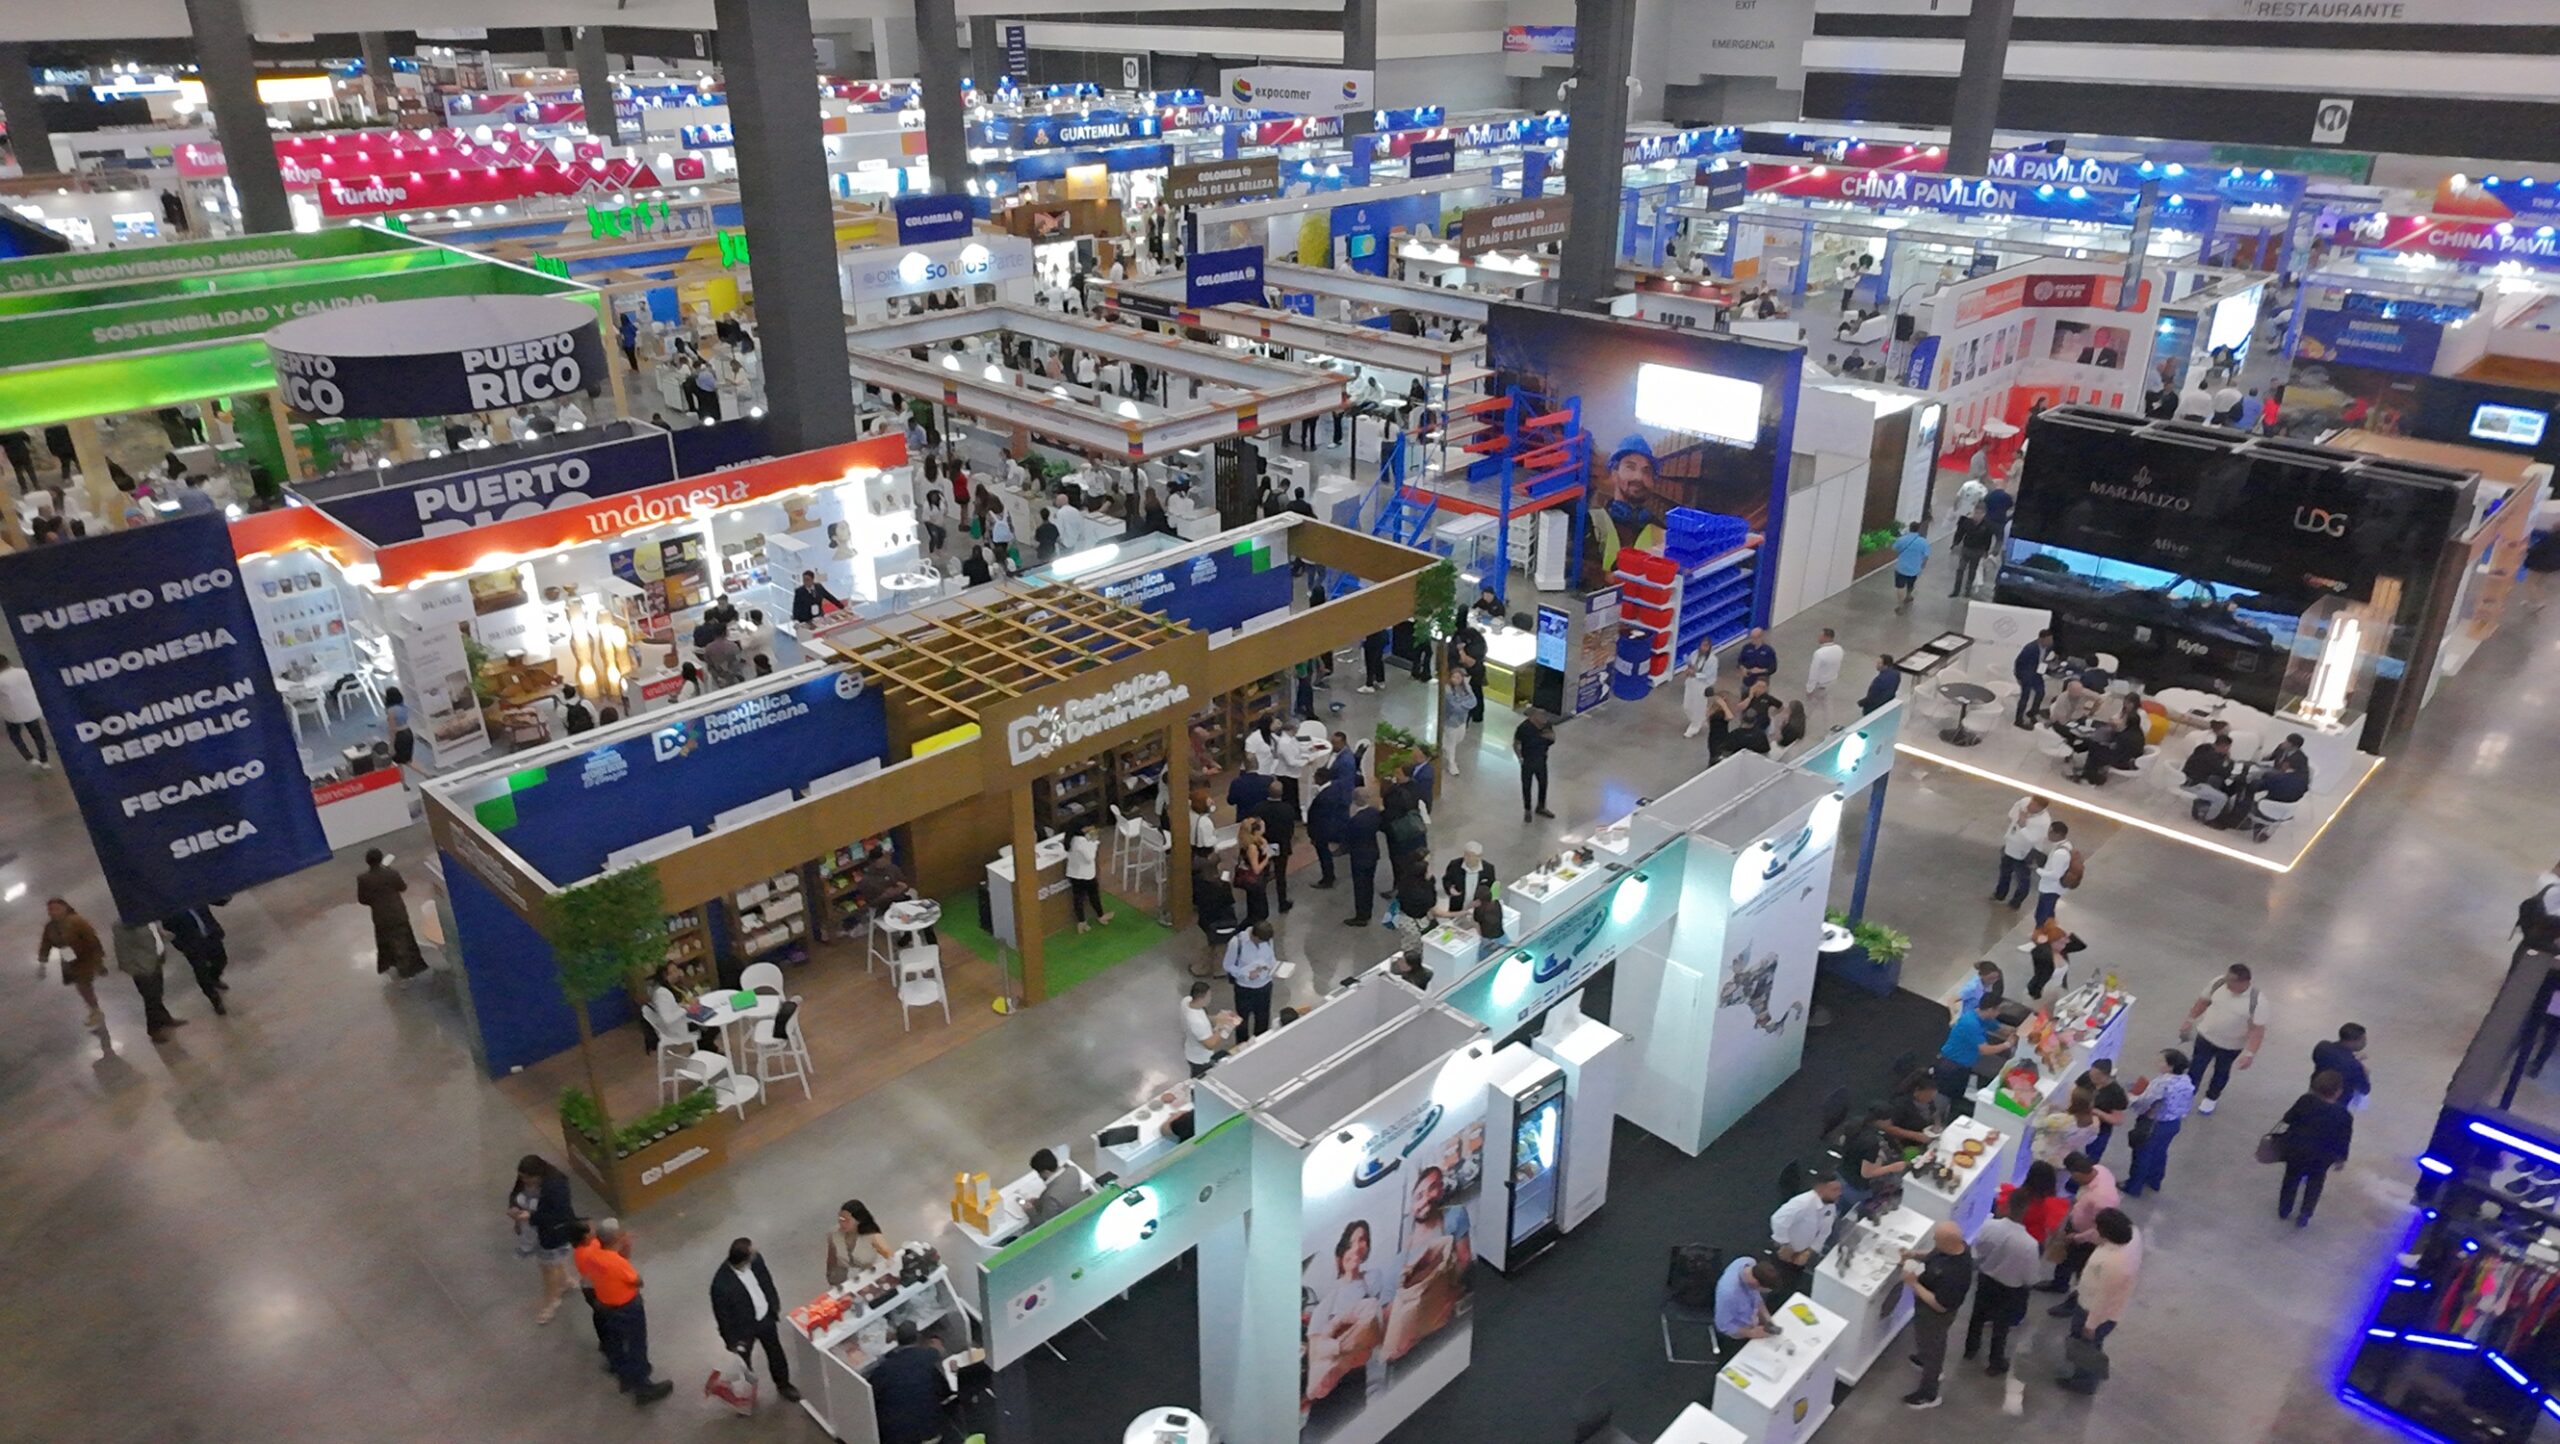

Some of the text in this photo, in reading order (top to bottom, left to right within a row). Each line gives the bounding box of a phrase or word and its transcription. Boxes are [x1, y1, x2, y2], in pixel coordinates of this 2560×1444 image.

[2256, 1, 2405, 19] RESTAURANTE
[1711, 38, 1776, 50] EMERGENCIA
[1254, 87, 1312, 101] expocomer
[1060, 122, 1131, 142] GUATEMALA
[1840, 176, 2017, 210] CHINA PAVILION
[2021, 158, 2119, 186] PAVILION
[2427, 229, 2494, 251] CHINA
[10, 275, 35, 290] DE
[41, 270, 69, 286] LA
[71, 255, 216, 283] BIODIVERSIDAD
[218, 247, 298, 268] MUNDIAL
[92, 307, 270, 344] SOSTENIBILIDAD
[271, 303, 287, 320] Y
[462, 332, 575, 374] PUERTO
[466, 356, 582, 410] RICO
[413, 458, 591, 521] PUERTO
[585, 479, 751, 535] indonesia
[2088, 480, 2192, 512] MARJALIZO
[18, 567, 234, 635] PUERTO RICO
[58, 626, 239, 688] INDONESIA
[74, 676, 256, 744] DOMINICAN
[703, 690, 792, 732] República
[1064, 669, 1172, 722] República
[1065, 683, 1191, 744] Dominicana
[100, 707, 252, 766] REPUBLIC
[705, 700, 810, 746] Dominicana
[120, 758, 266, 819] FECAMCO
[169, 818, 258, 860] SIECA
